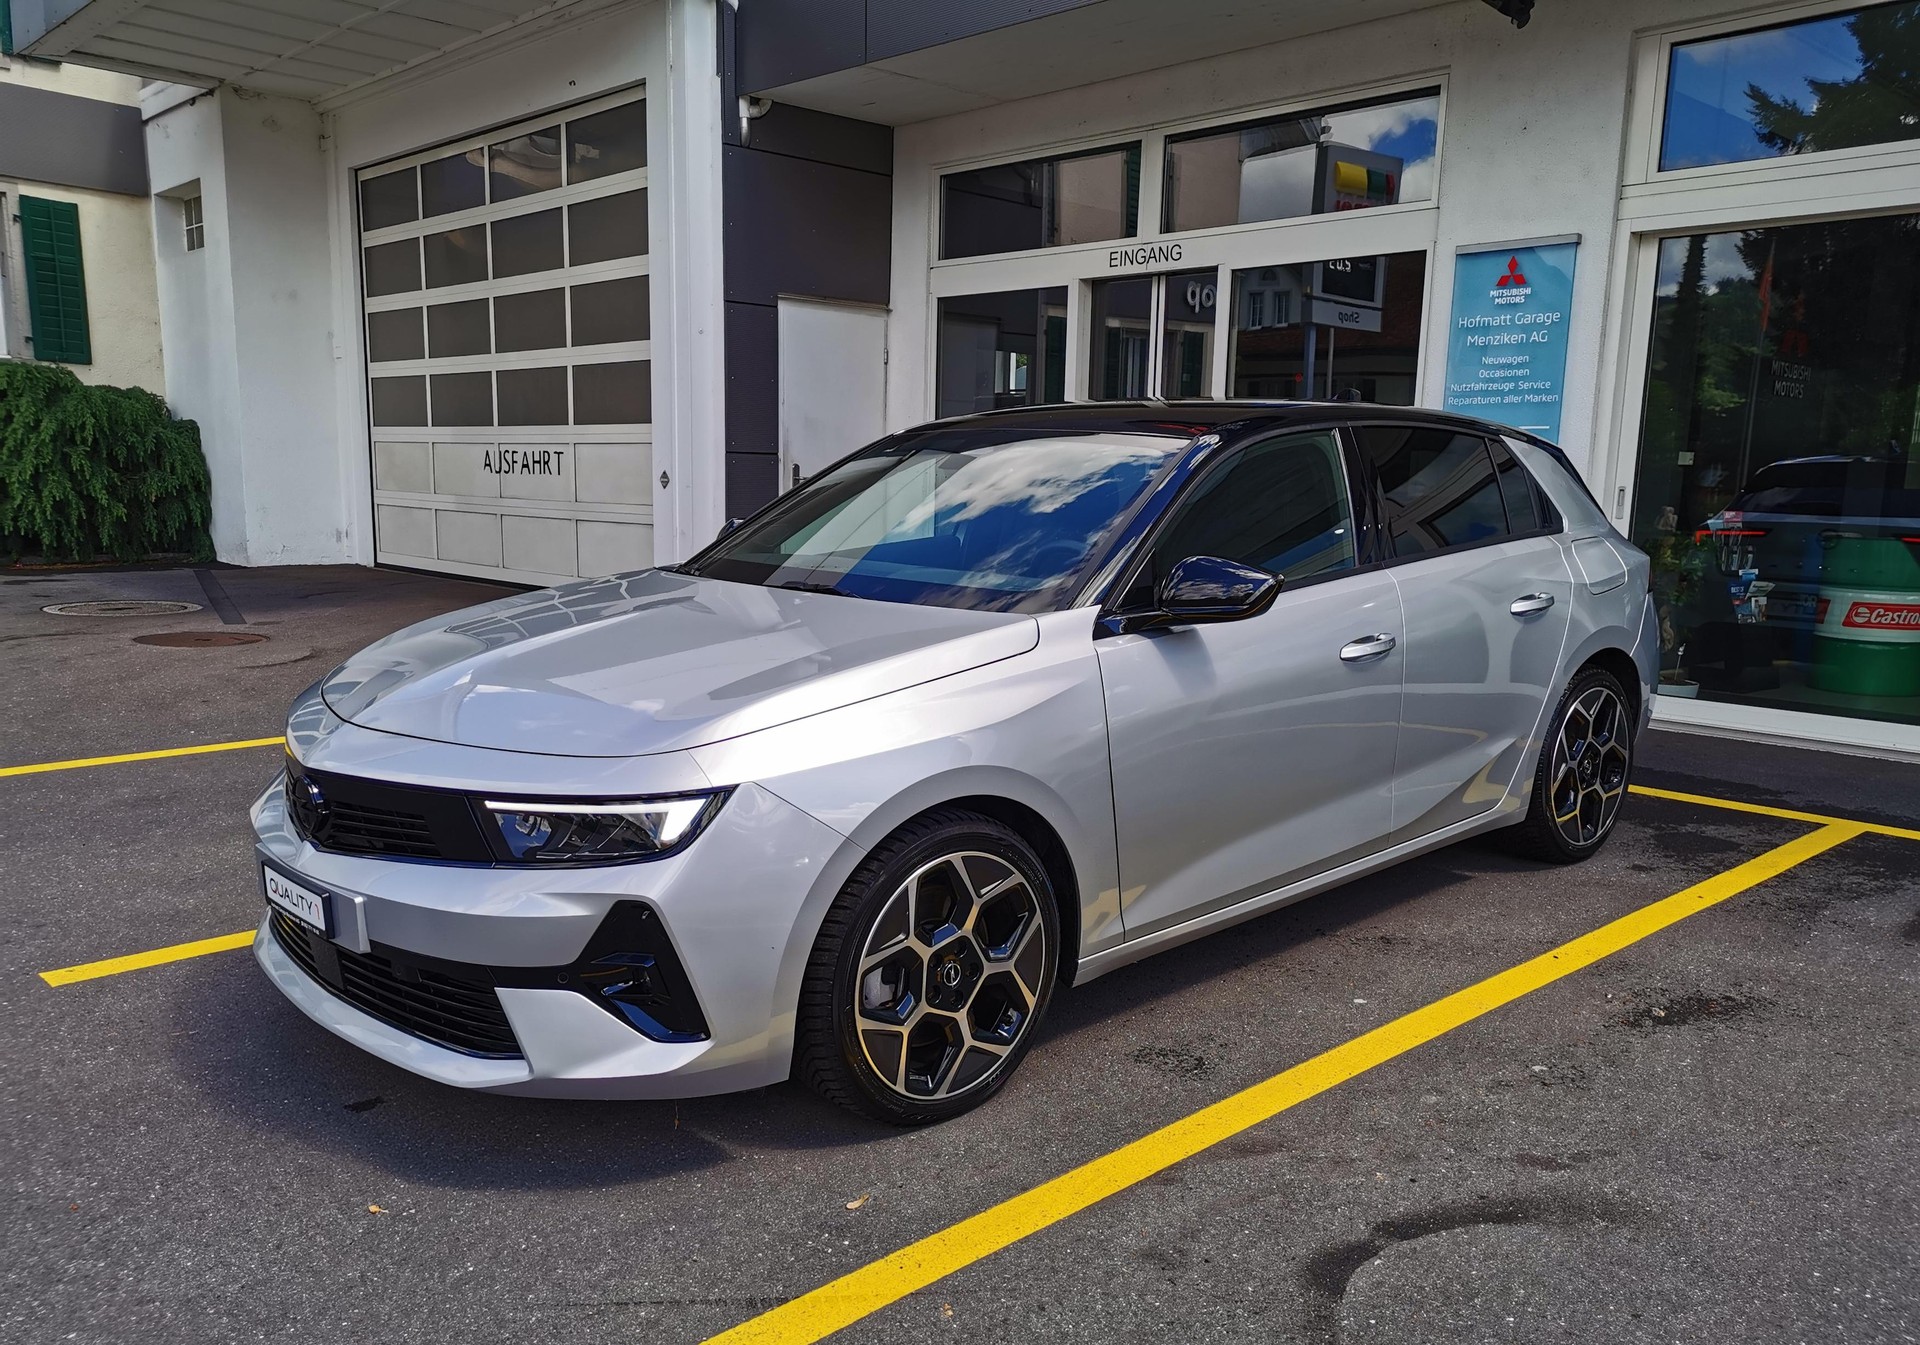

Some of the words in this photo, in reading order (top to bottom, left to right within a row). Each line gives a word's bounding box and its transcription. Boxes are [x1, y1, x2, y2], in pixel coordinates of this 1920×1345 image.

[1109, 243, 1183, 268] EINGANG
[1489, 288, 1531, 297] MITSUBISHI
[1495, 296, 1525, 304] MOTORS
[1458, 314, 1512, 329] Hofmatt
[1514, 311, 1561, 326] Garage
[1466, 332, 1527, 347] Menziken
[1529, 330, 1548, 343] AG
[1481, 355, 1529, 366] Neuwagen
[1479, 368, 1529, 378] Occasionen
[1771, 360, 1811, 381] MITSUBISHI
[1450, 382, 1515, 392] Nutzfahrzeuge
[1518, 380, 1552, 390] Service
[1774, 380, 1804, 399] MOTORS
[1448, 396, 1501, 406] Reparaturen
[1503, 394, 1523, 404] aller
[1524, 393, 1559, 403] Marken
[483, 449, 564, 476] AUSFAHRT
[1870, 608, 1920, 625] Castro
